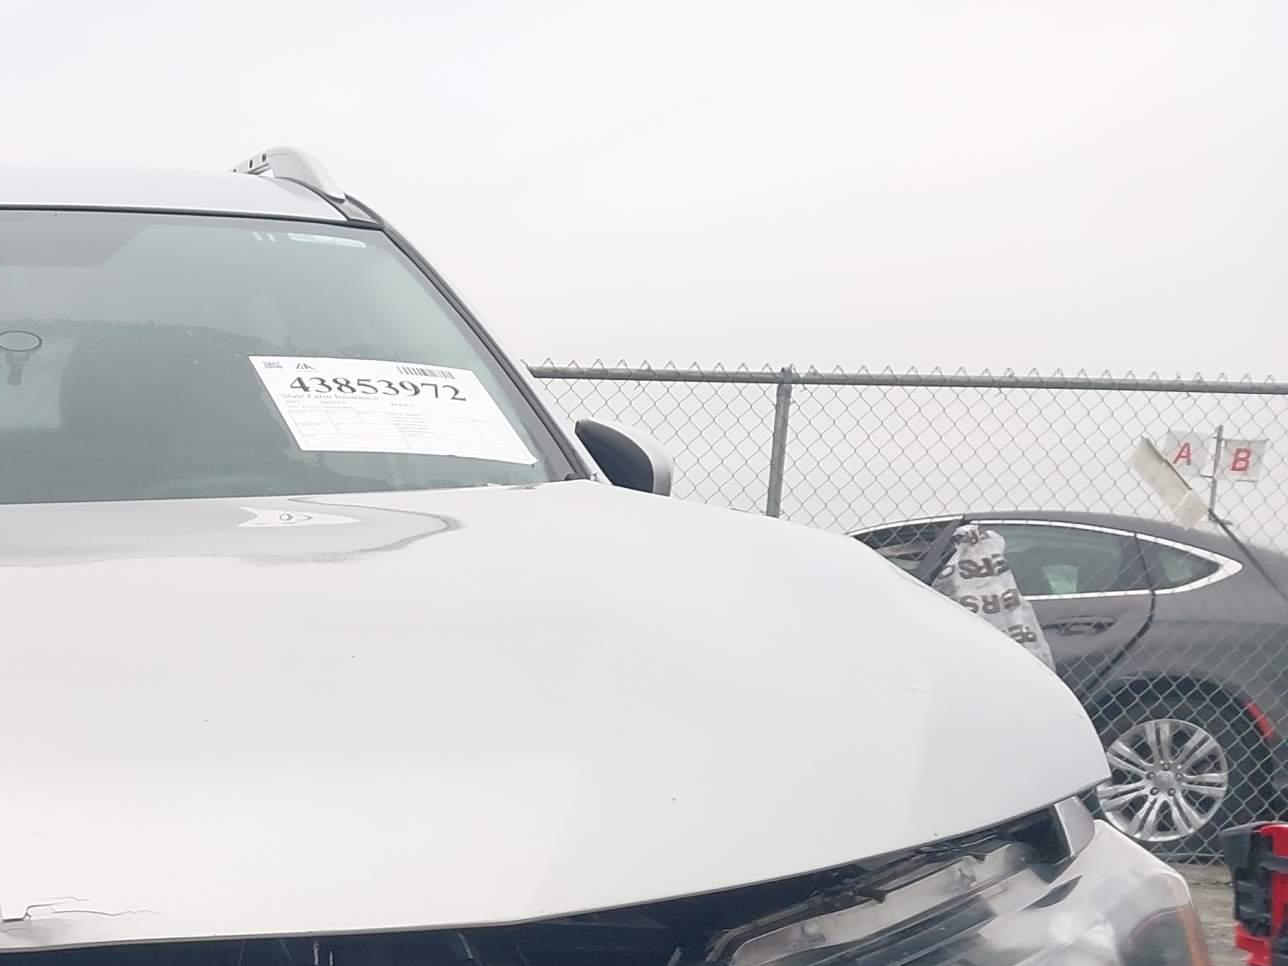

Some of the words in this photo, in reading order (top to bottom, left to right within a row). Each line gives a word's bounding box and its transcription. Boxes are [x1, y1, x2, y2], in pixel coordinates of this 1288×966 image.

[289, 376, 467, 401] 43853972
[1173, 442, 1192, 466] A
[1230, 447, 1253, 472] B
